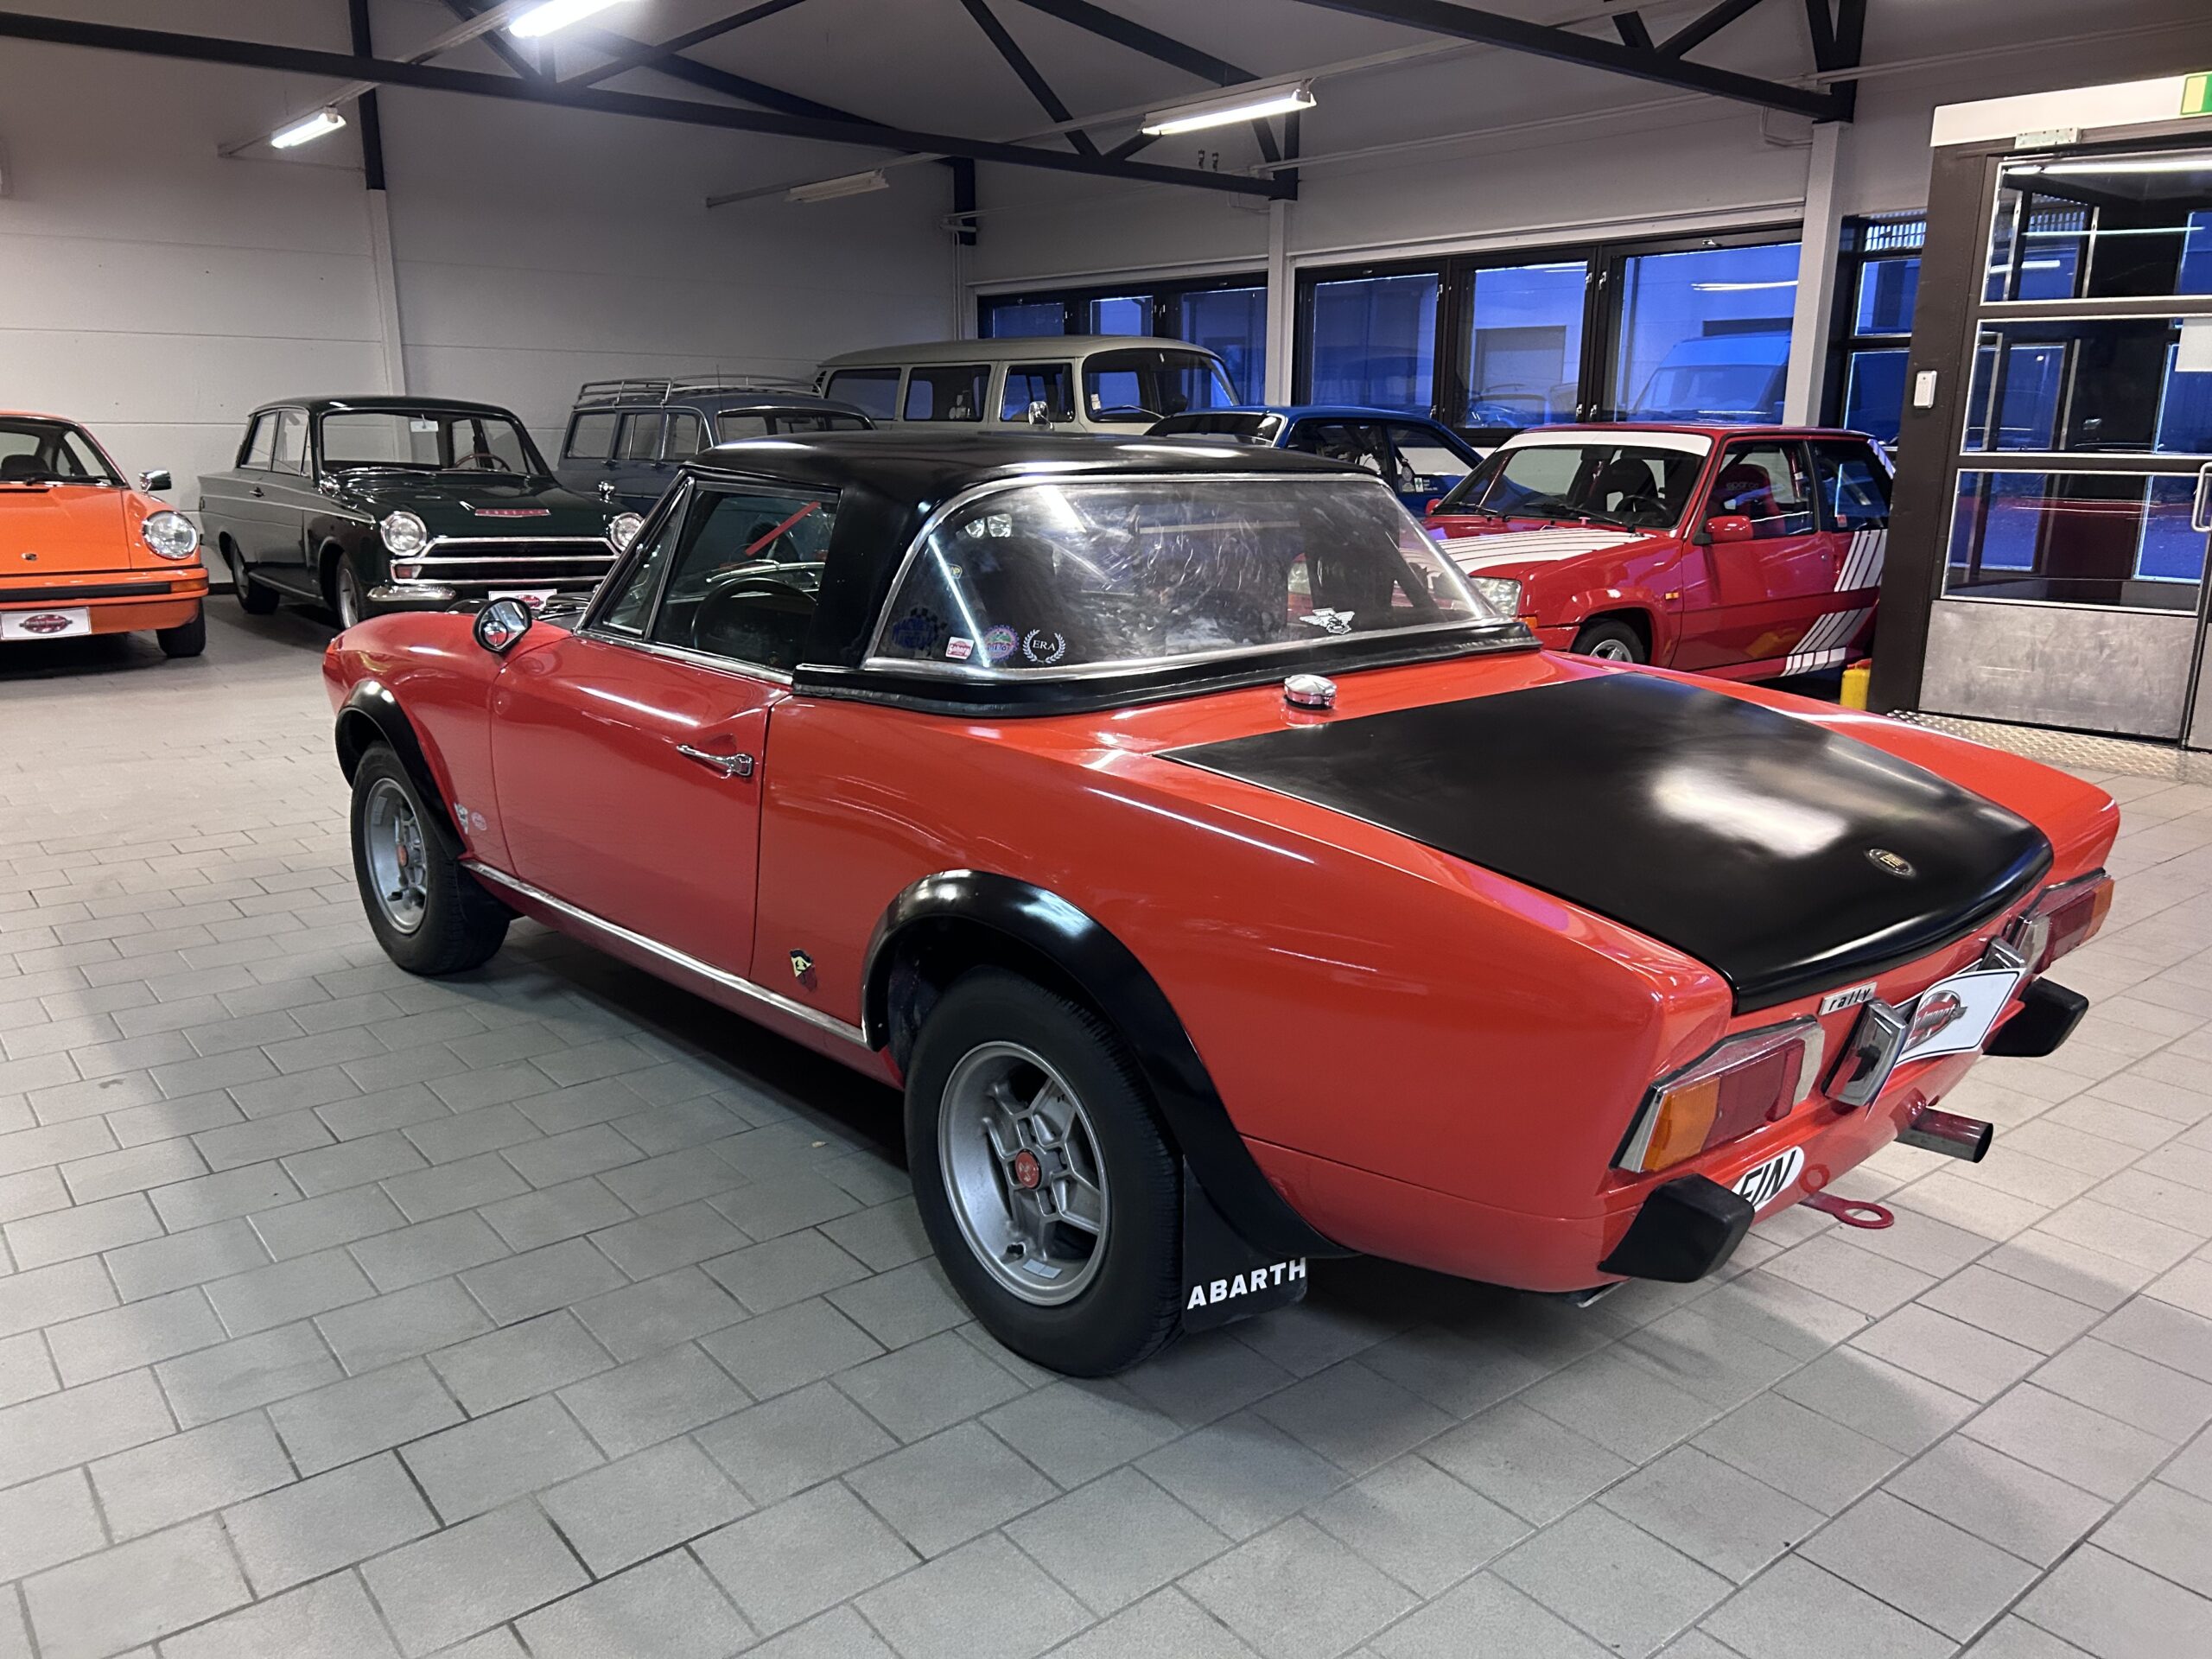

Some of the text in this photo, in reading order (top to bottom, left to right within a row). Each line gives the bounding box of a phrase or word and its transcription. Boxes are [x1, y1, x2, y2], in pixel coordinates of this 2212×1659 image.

[1033, 639, 1055, 651] ERA
[1828, 988, 1871, 1011] rally
[1738, 1149, 1796, 1207] FIN
[1186, 1256, 1306, 1310] ABARTH
